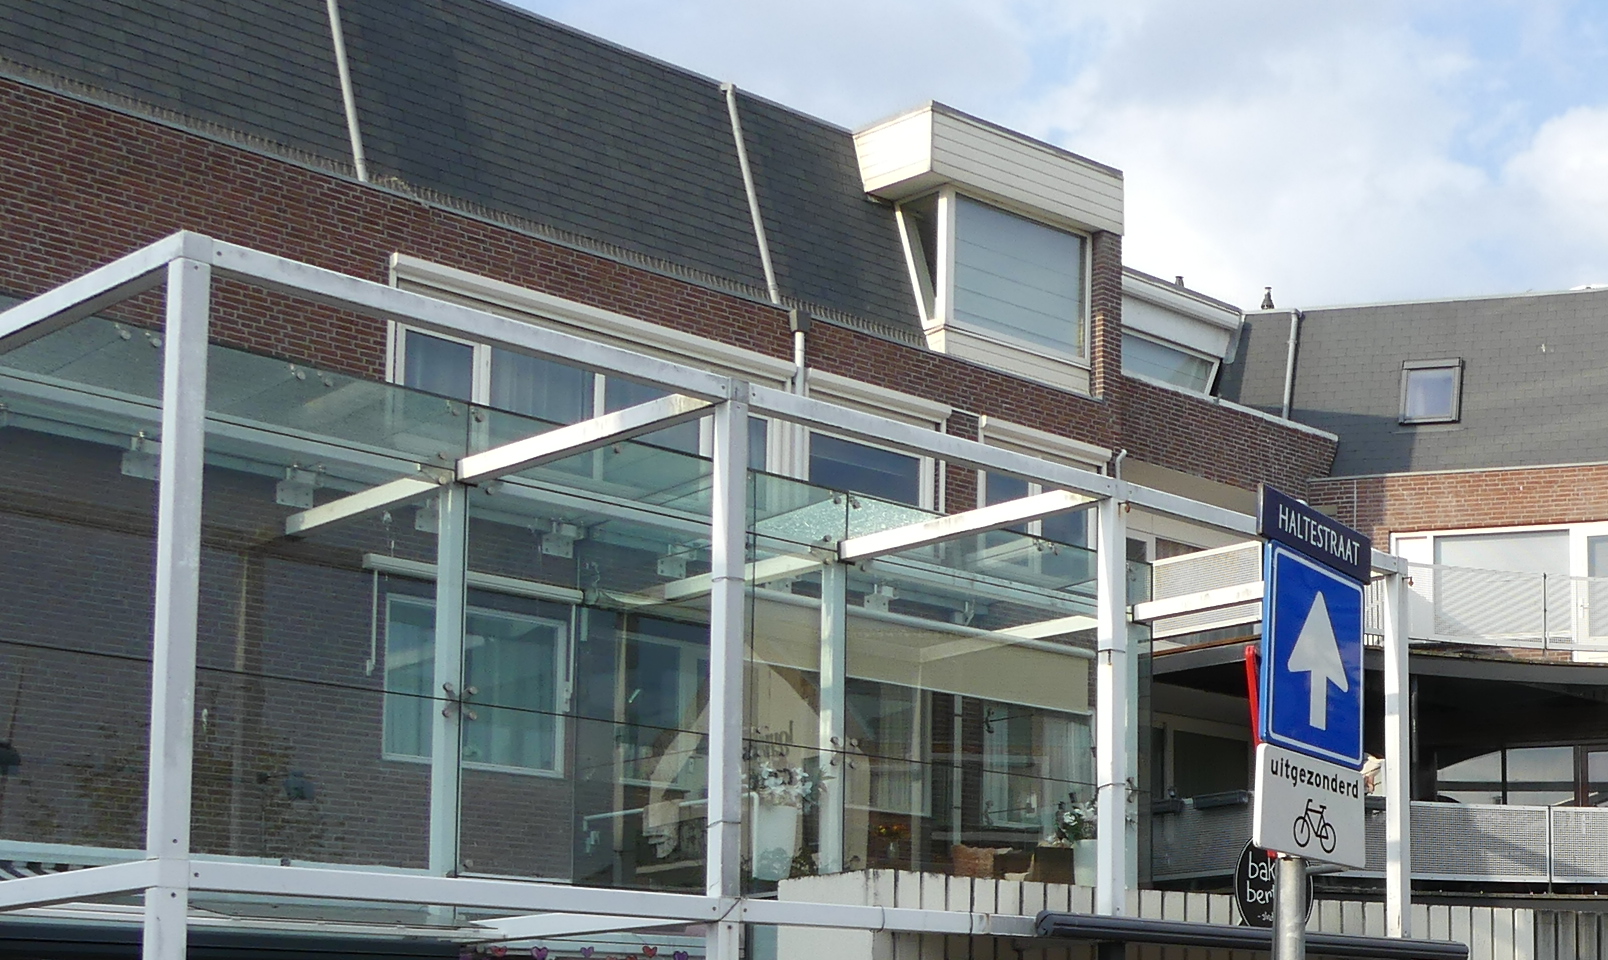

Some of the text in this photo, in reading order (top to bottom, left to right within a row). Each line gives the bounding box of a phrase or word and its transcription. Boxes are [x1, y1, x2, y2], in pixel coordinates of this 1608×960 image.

[1278, 504, 1360, 566] HALTESTRAAT
[1270, 758, 1359, 799] uitgezonderd
[1248, 851, 1275, 882] bak
